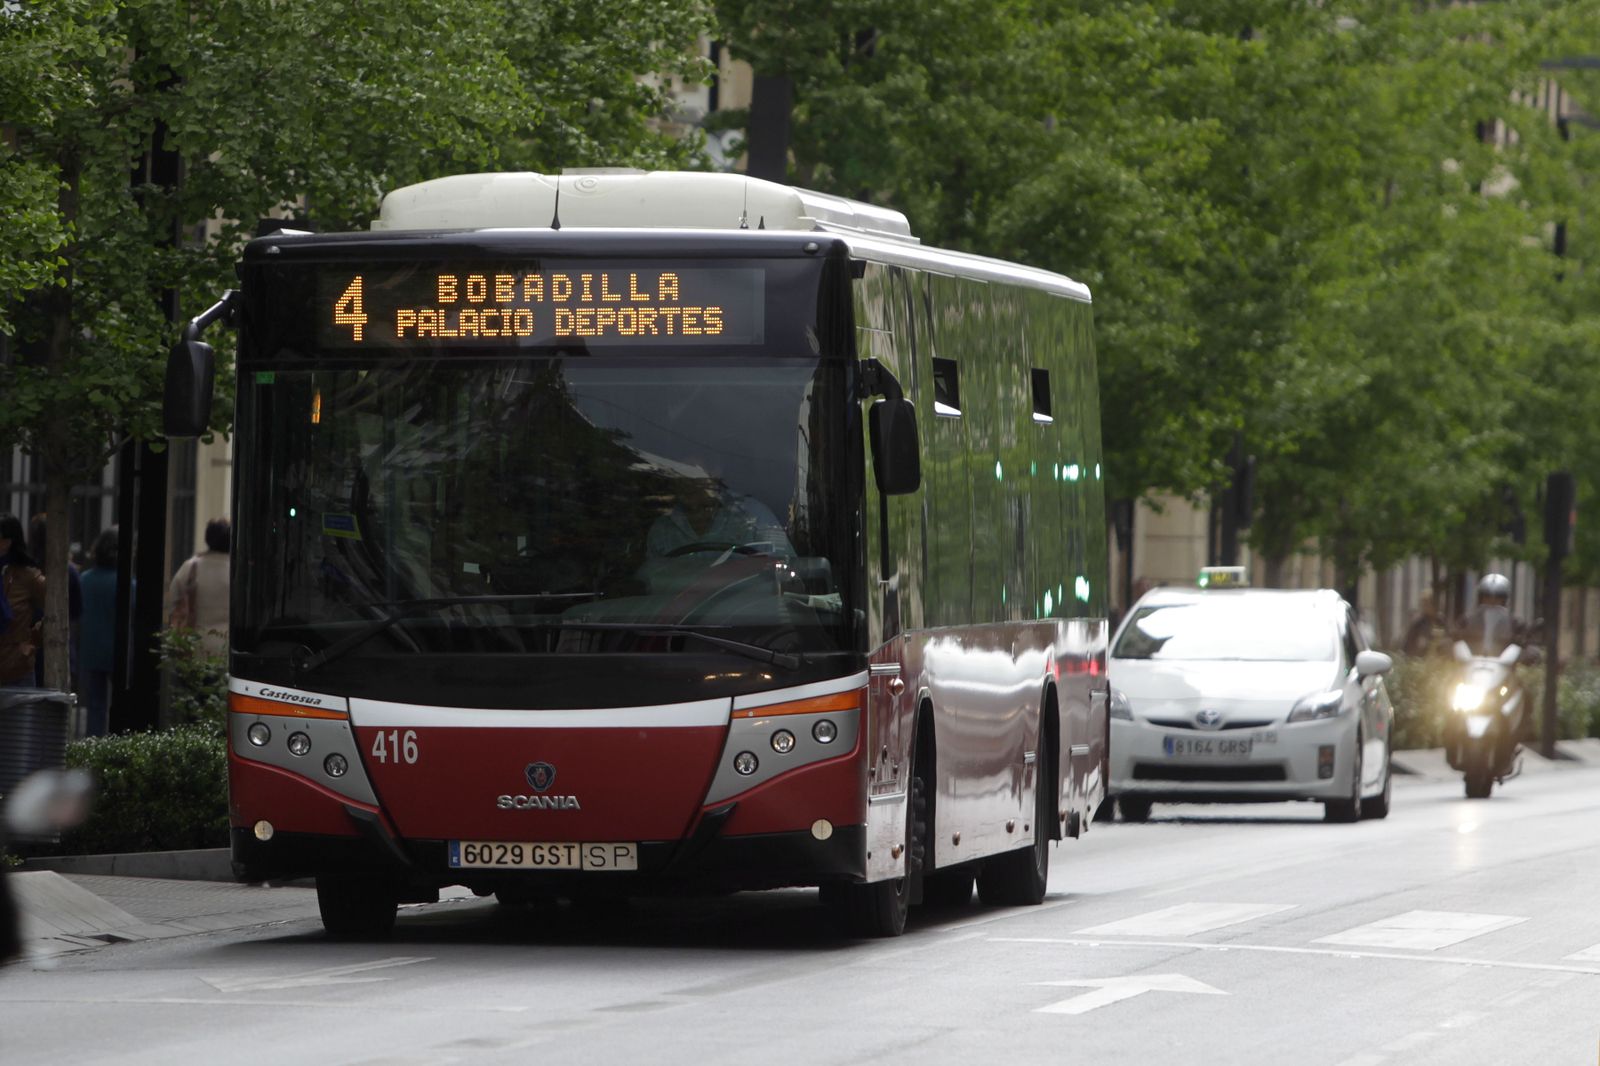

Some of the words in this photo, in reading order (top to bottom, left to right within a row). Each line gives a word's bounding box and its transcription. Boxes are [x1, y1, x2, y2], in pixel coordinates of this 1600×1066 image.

[438, 273, 679, 302] BOBADILLA
[335, 276, 367, 341] 4
[397, 309, 534, 337] PALACIO
[555, 306, 723, 336] DEPORTES
[259, 687, 322, 706] Castrosua
[372, 730, 418, 764] 416
[497, 795, 581, 809] SCANIA
[464, 844, 524, 865] 6029
[532, 845, 575, 866] GST
